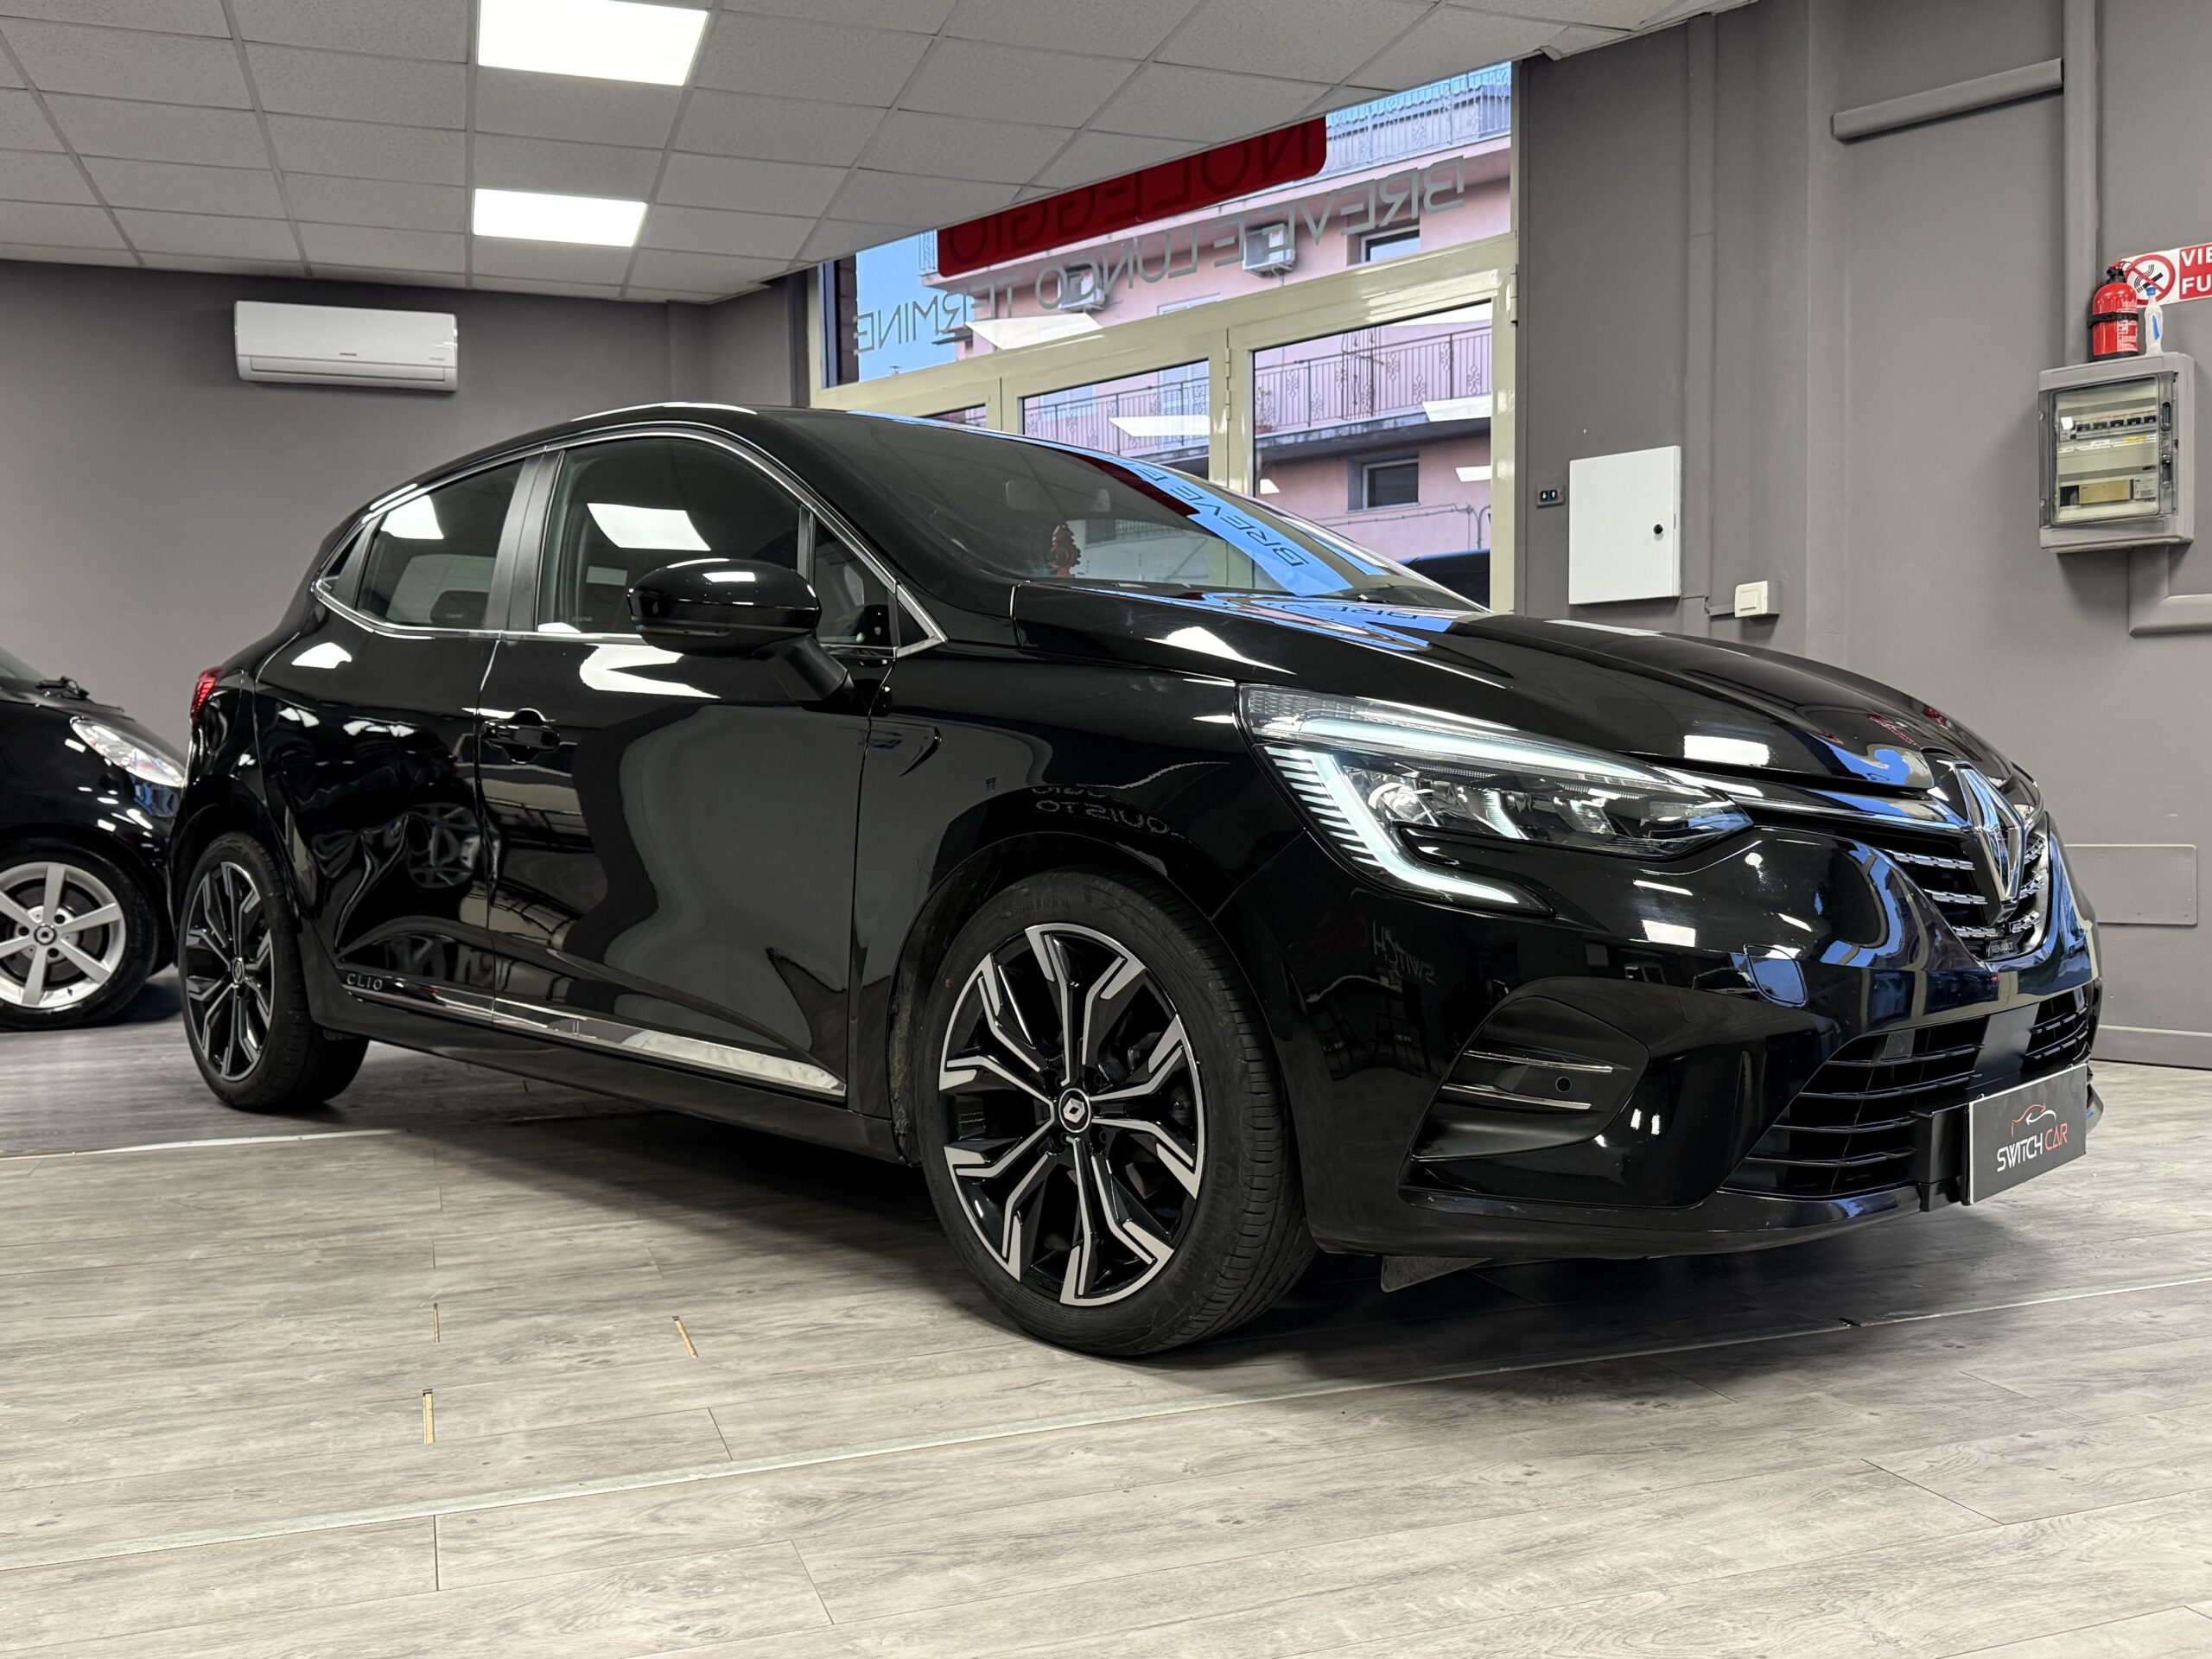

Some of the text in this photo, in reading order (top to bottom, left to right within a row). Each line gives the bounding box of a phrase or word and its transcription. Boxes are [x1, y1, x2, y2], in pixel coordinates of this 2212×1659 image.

[346, 973, 383, 990] CLIO
[1997, 1122, 2068, 1173] SWITCH CAR
